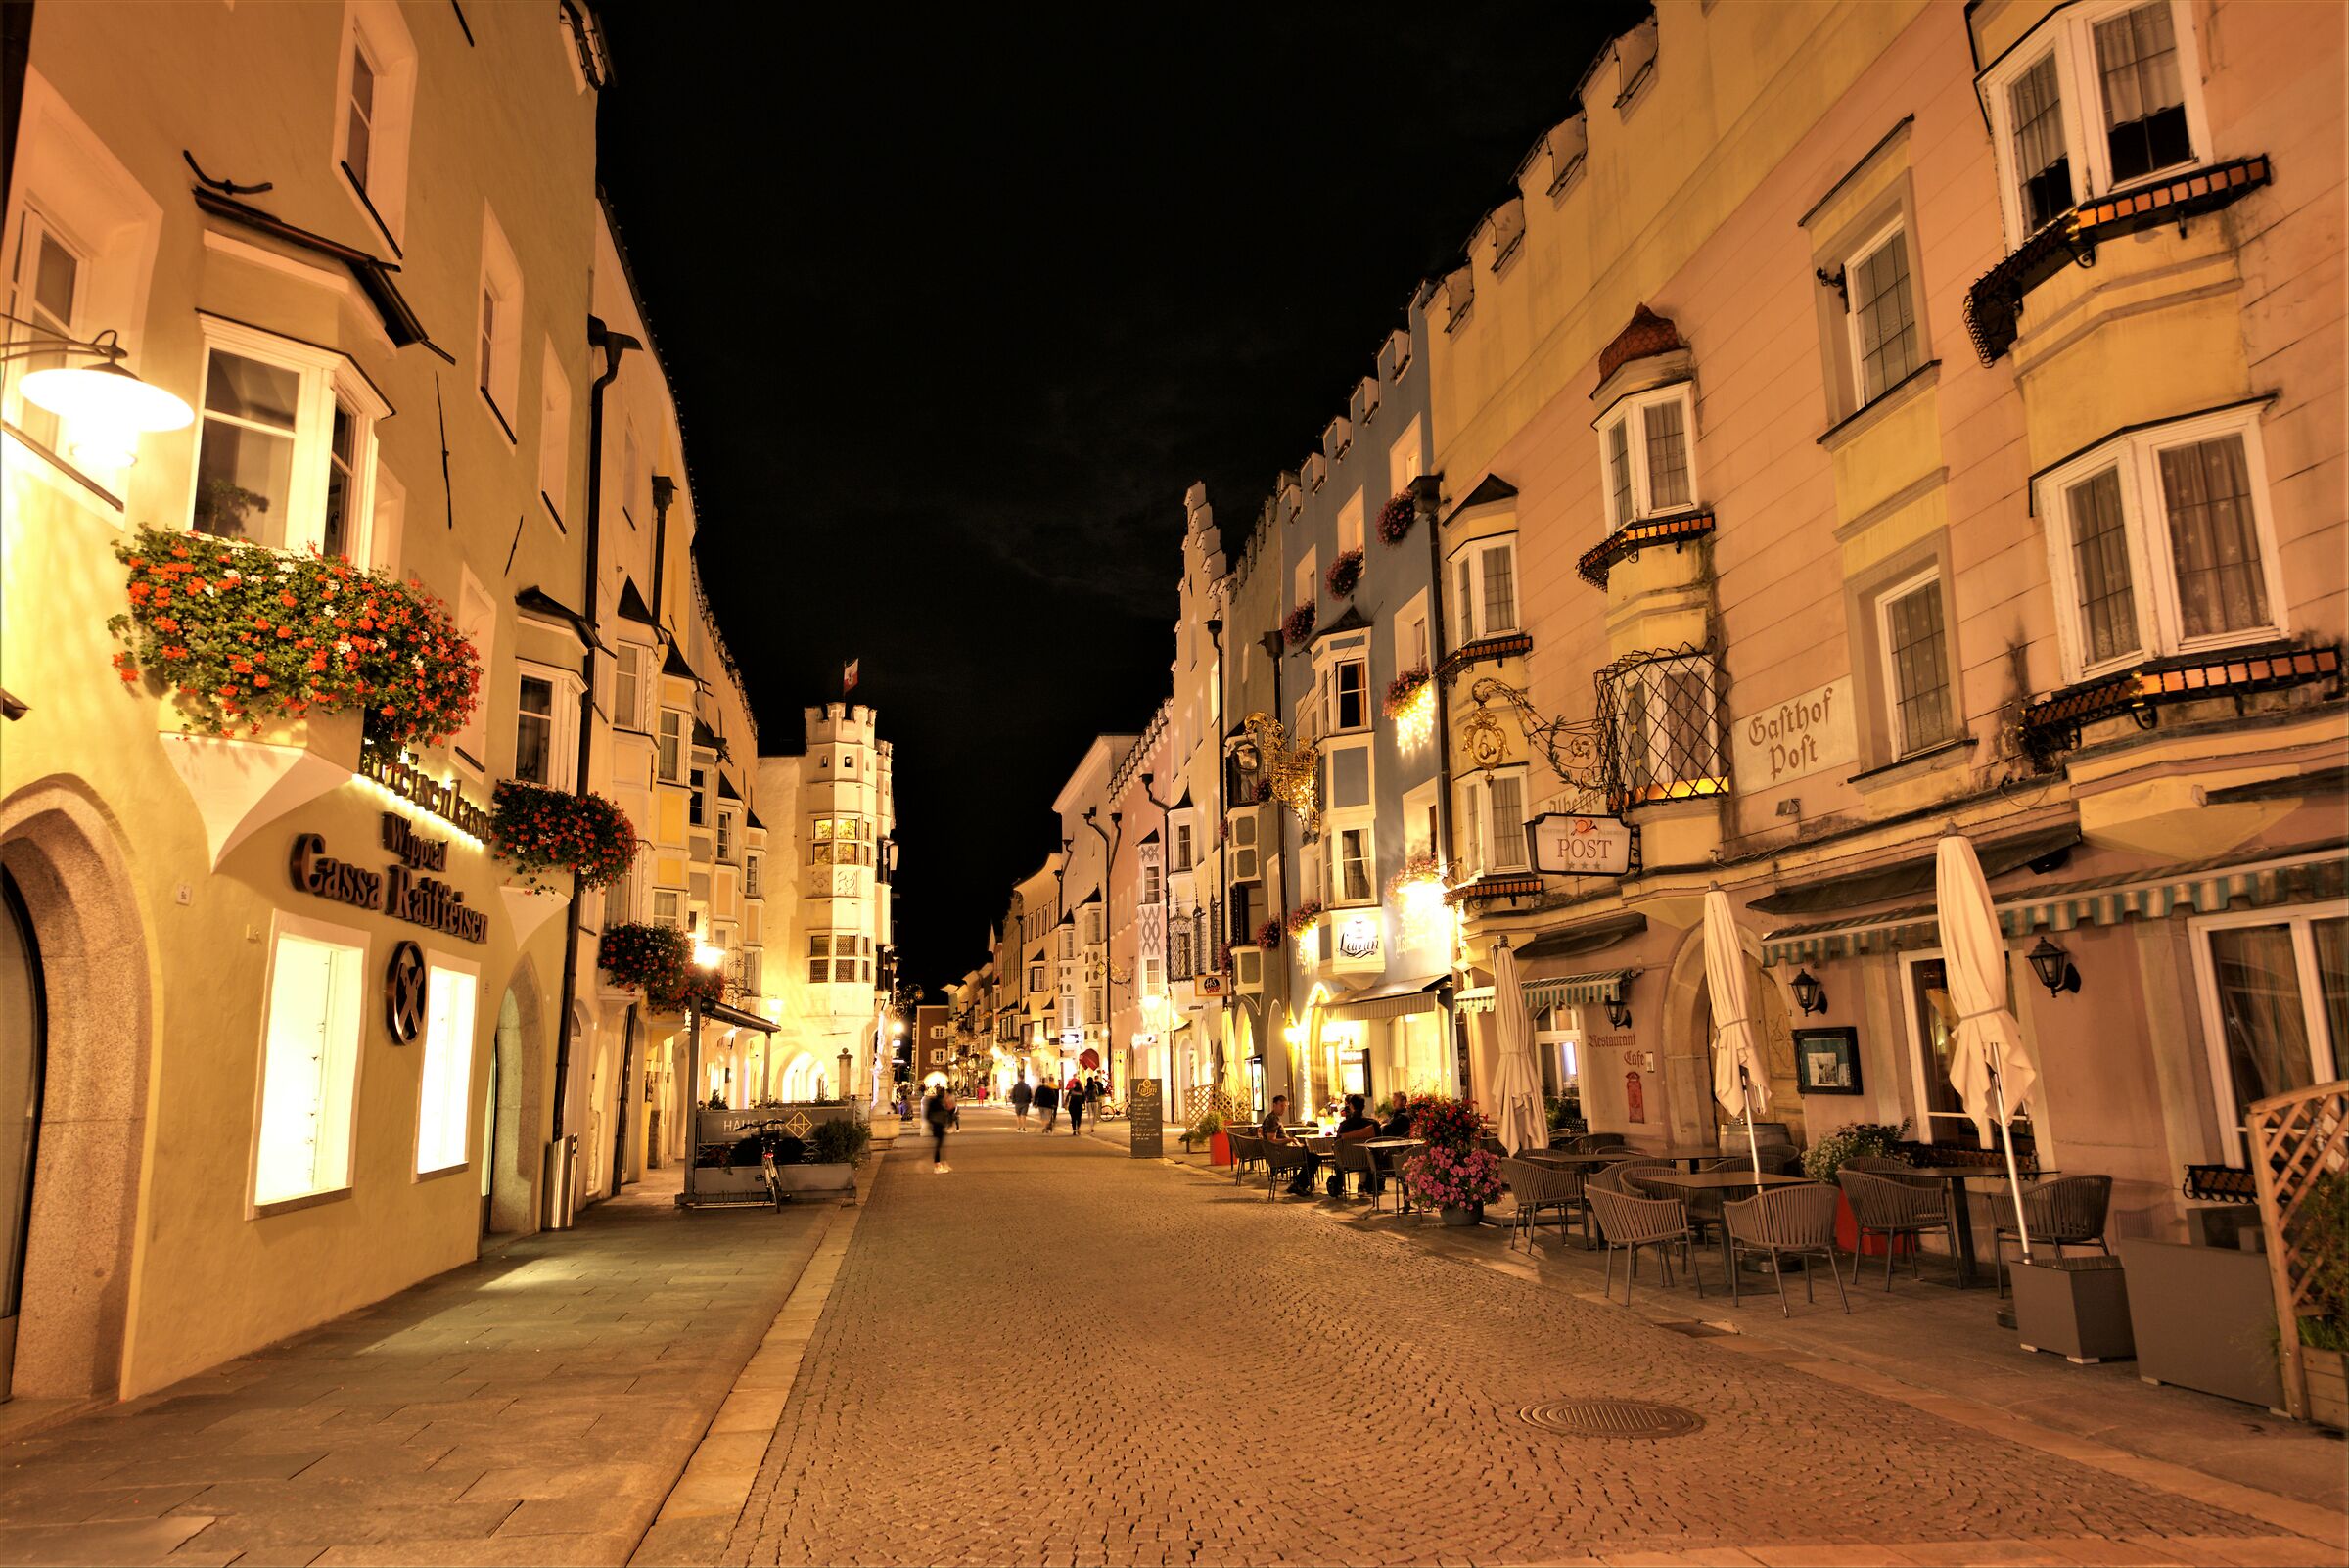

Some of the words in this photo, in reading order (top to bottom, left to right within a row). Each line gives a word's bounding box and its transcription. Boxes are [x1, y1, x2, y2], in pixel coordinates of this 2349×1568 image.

[382, 811, 448, 872] Wipptal
[1557, 838, 1612, 858] POST
[290, 833, 383, 910] Cassa
[385, 864, 488, 944] Raiffeisen
[1588, 1033, 1636, 1047] Restaurant
